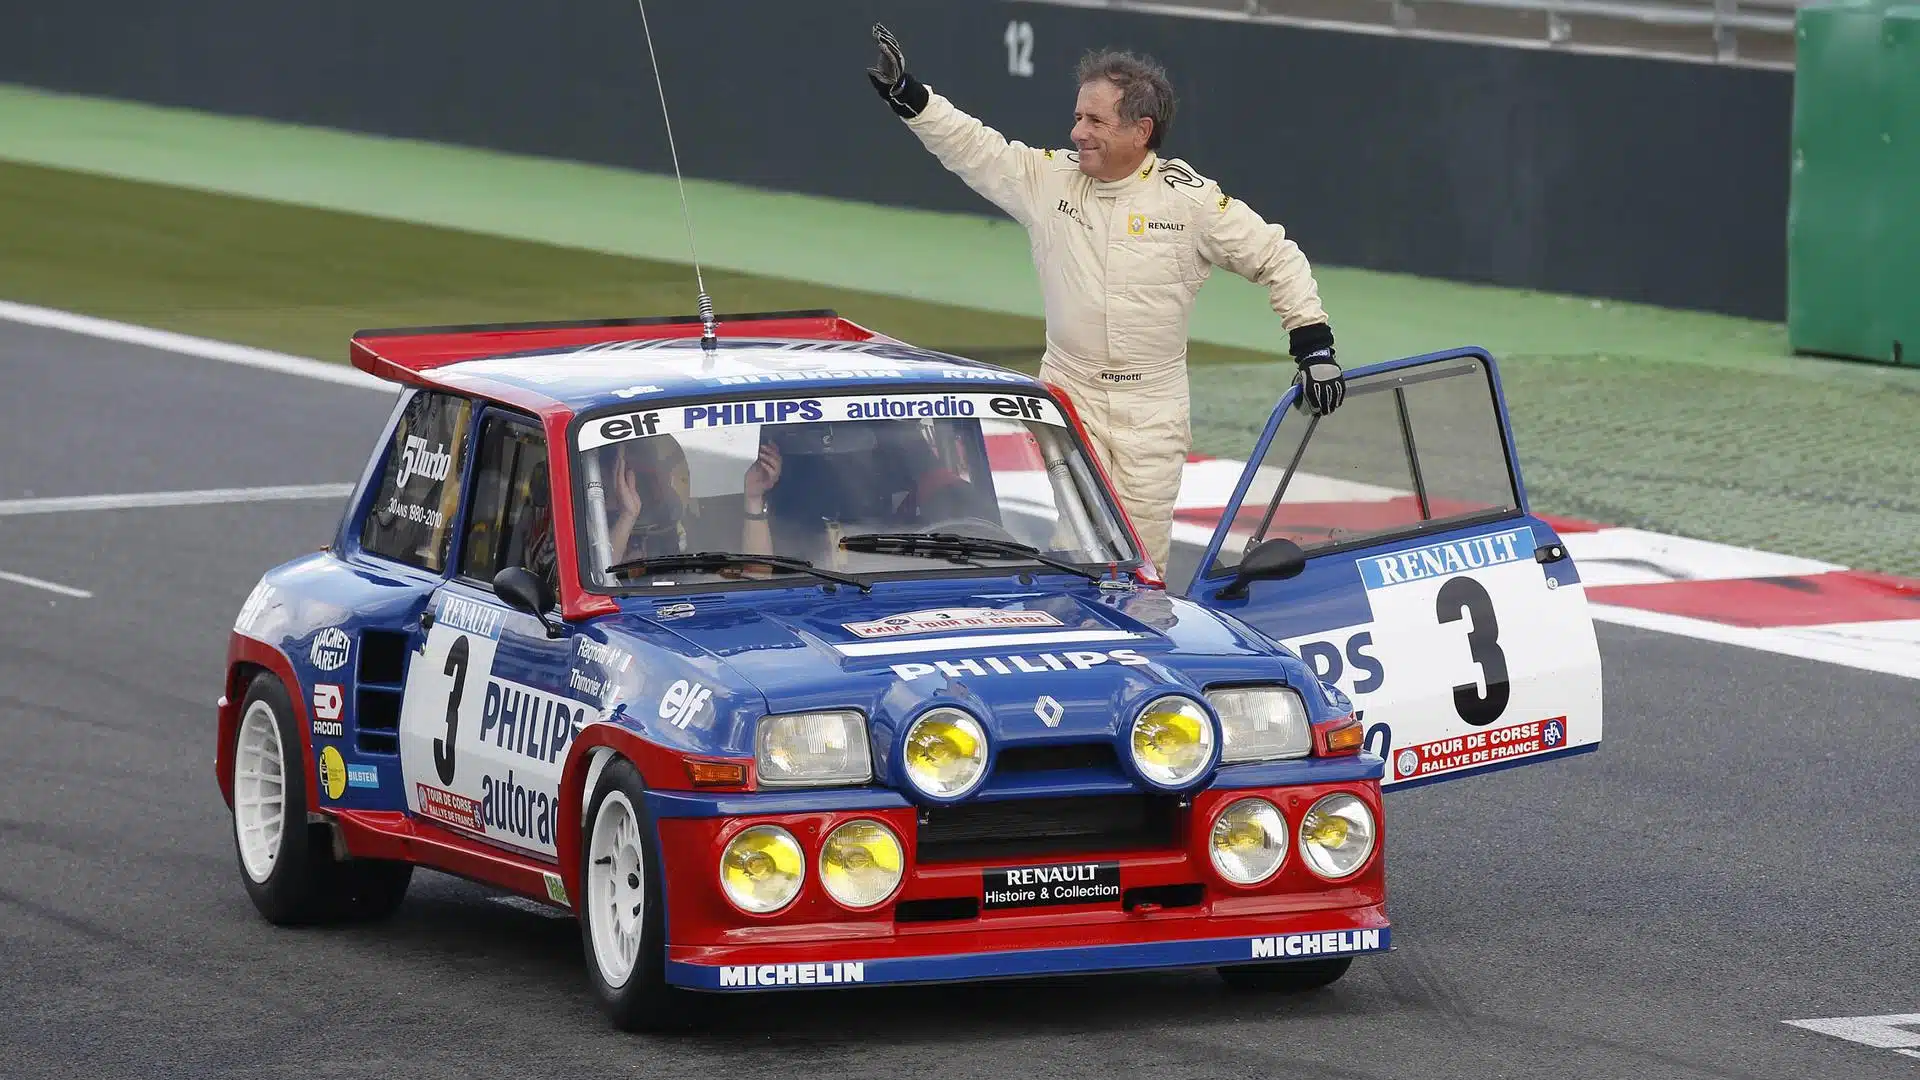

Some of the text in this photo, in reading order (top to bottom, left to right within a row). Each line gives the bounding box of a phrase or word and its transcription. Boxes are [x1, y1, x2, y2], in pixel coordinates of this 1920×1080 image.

[1003, 20, 1035, 77] 12
[1148, 222, 1186, 231] RENAULT
[1101, 372, 1142, 382] Ragnotti
[600, 396, 1043, 440] elf PHILIPS autoradio elf
[388, 497, 442, 528] 30 ANS 1980-2010
[1375, 532, 1518, 586] RENAULT
[440, 596, 501, 637] RENAULT
[917, 619, 961, 631] TOUR
[966, 617, 982, 627] DE
[990, 614, 1047, 625] CORSE
[889, 649, 1151, 682] PHILIPS
[1436, 576, 1510, 726] 3
[433, 635, 469, 786] 3
[659, 680, 712, 730] elf
[313, 720, 342, 736] FACOM
[1422, 723, 1540, 758] TOUR DE CORSE
[1422, 740, 1540, 772] RALLYE DE FRANCE
[348, 771, 377, 782] BILSTEIN
[426, 787, 444, 805] TOUR
[452, 794, 473, 813] CORSE
[428, 804, 448, 820] RALLYE
[455, 812, 475, 828] FRANCE
[1006, 864, 1099, 886] RENAULT
[985, 884, 1119, 904] Histoire & Collection
[1251, 929, 1379, 958] MICHELIN
[719, 962, 864, 987] MICHELIN
